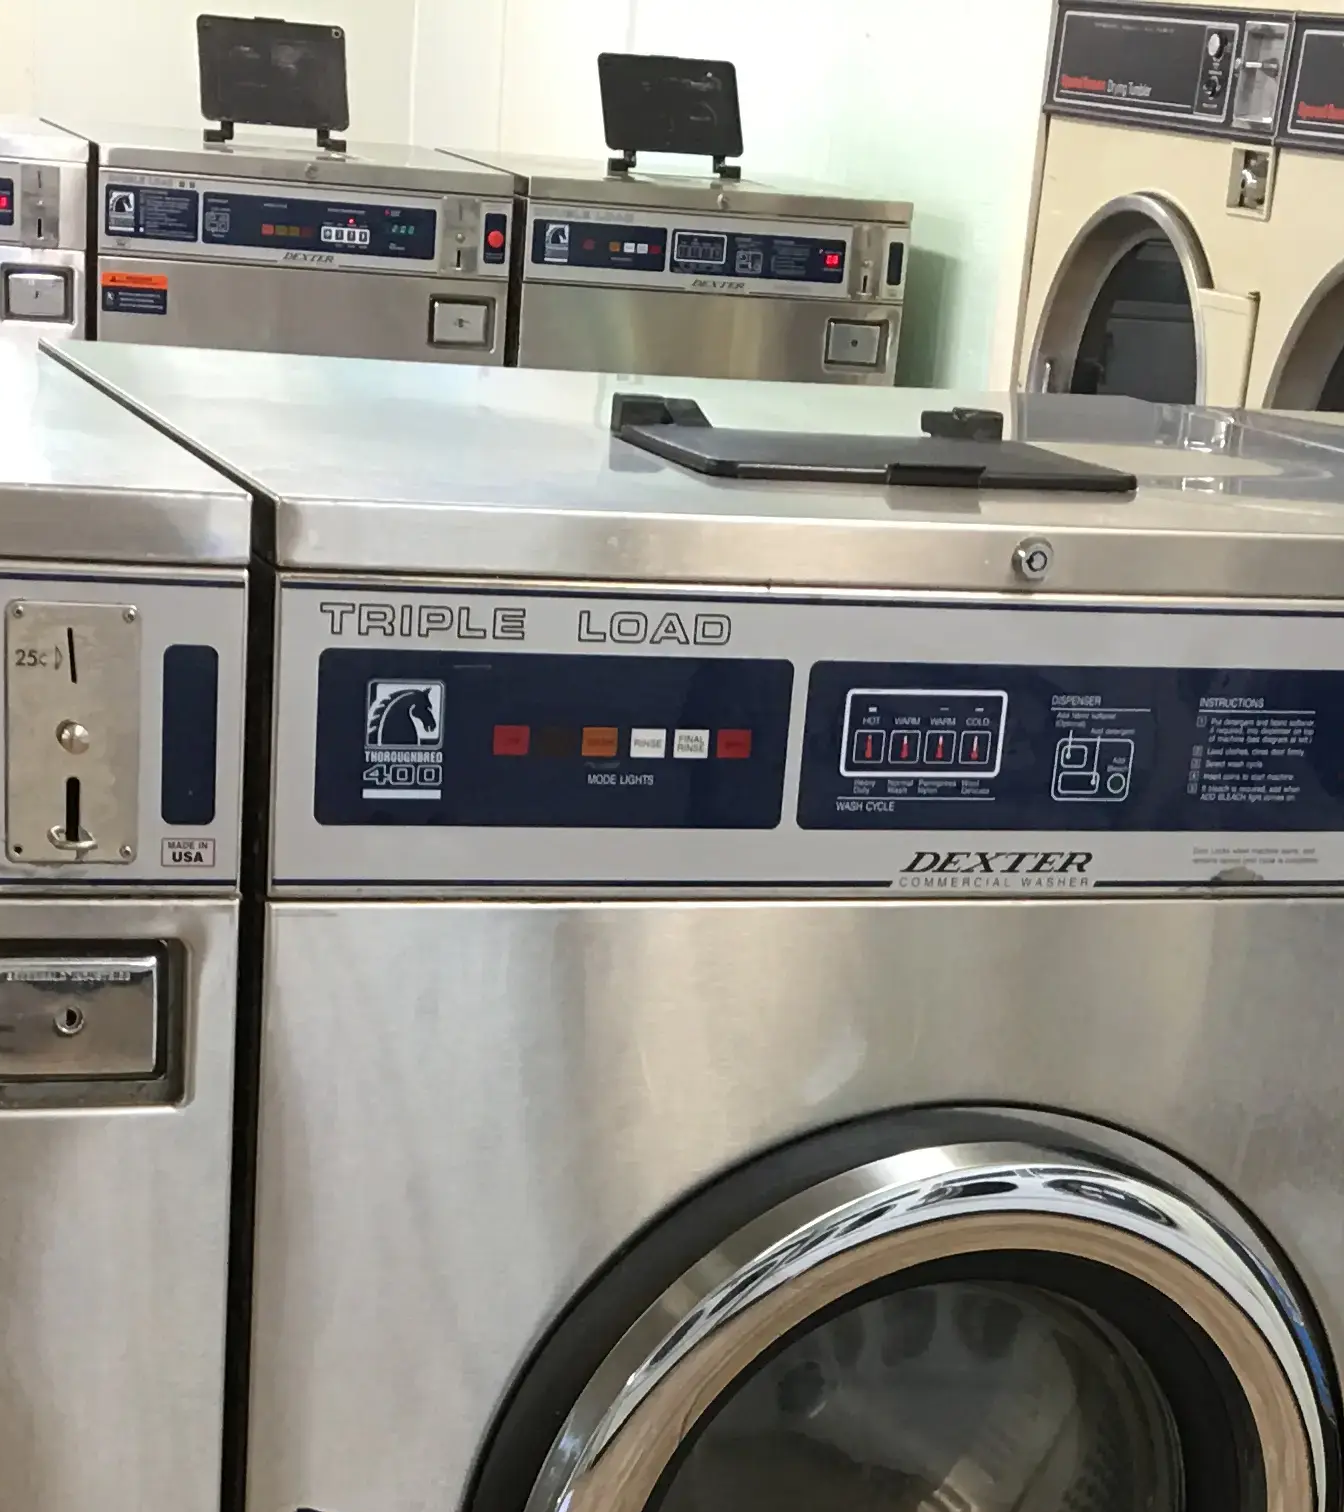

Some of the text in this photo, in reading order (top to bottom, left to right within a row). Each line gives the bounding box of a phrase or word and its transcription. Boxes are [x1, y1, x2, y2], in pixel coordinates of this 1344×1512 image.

[319, 601, 733, 646] TRIPLE LOAD
[1052, 695, 1101, 706] DISPENSER
[1200, 698, 1264, 708] INSTRUCTIONS
[862, 716, 880, 725] HOT
[894, 717, 921, 725] WARM
[930, 717, 956, 726] WARM
[966, 718, 990, 727] COLD
[633, 739, 662, 749] RINSE
[678, 735, 704, 744] FINAL
[677, 744, 704, 753] RINSE
[364, 751, 443, 763] THOROUGHBRED
[363, 764, 442, 786] 400
[587, 774, 654, 785] MODE LIGHTS
[836, 801, 895, 812] WASH CYCLE
[168, 841, 195, 849] MADE
[172, 851, 204, 862] USA
[899, 851, 1093, 873] DEXTER
[899, 877, 1089, 888] COMMERCIAL WASHER
